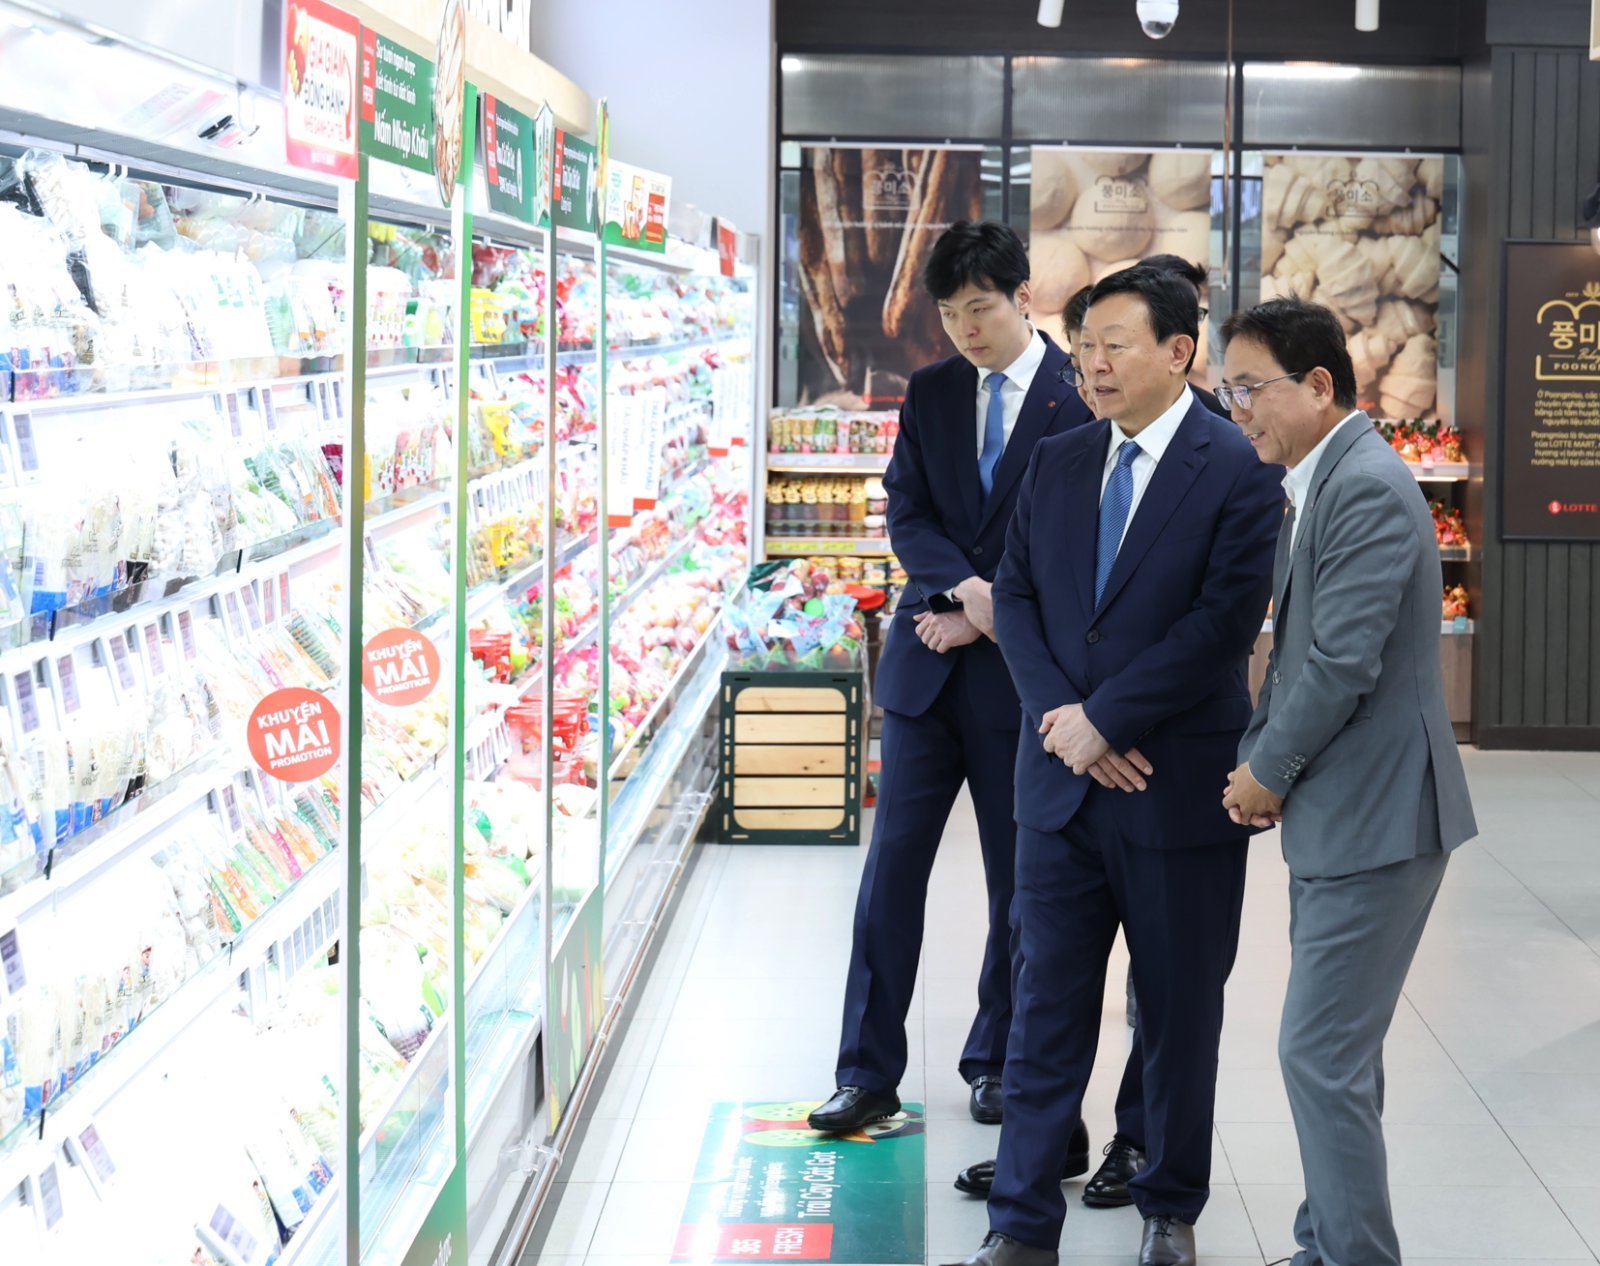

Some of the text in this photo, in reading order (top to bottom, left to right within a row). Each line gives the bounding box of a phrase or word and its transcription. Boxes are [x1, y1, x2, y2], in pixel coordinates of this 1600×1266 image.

[374, 108, 429, 159] Nấm Nhập Khẩu
[1554, 362, 1600, 371] POONG
[1549, 440, 1572, 448] LOTTE
[1563, 504, 1598, 512] LOTTE
[367, 638, 424, 662] KHUYẾN
[372, 652, 429, 688] MÃI
[376, 676, 432, 696] PROMOTION
[256, 700, 322, 728] KHUYẾN
[264, 716, 330, 760] MÃI
[270, 746, 332, 770] PROMOTION
[796, 1151, 844, 1218] Trái Cây Cắt Gọt
[731, 1238, 762, 1254] 365
[772, 1227, 805, 1254] FRESH
